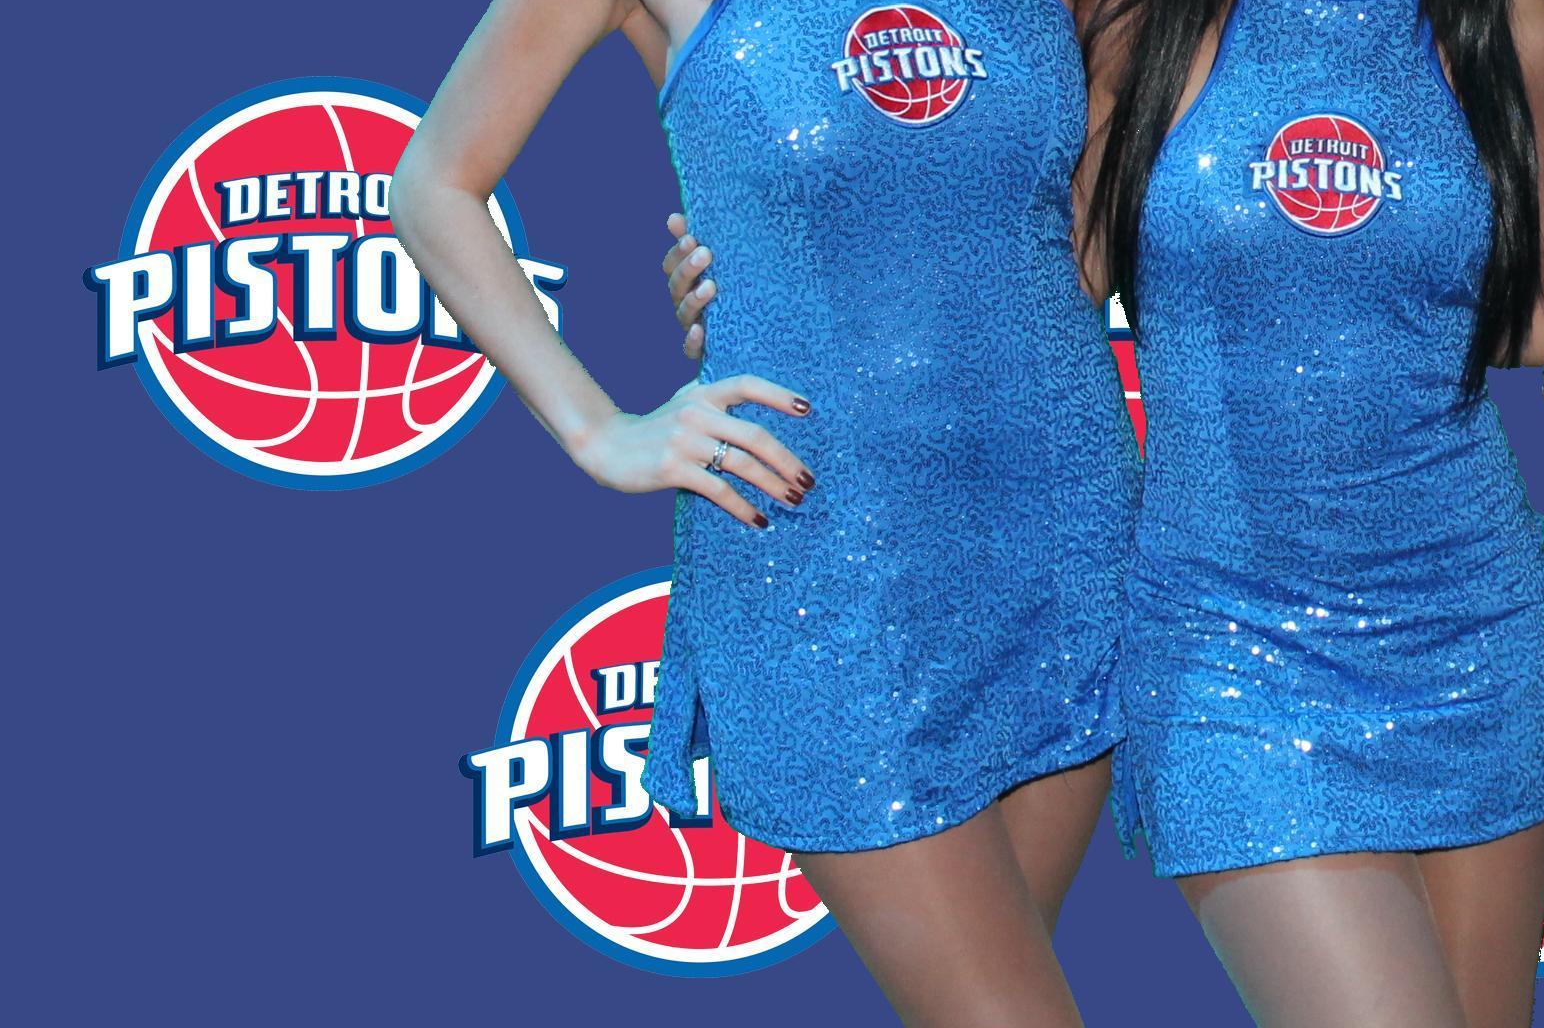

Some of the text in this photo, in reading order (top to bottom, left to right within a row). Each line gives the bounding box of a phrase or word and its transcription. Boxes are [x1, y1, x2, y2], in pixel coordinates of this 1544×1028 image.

[863, 27, 944, 49] DETROIT
[831, 46, 989, 92] PISTONS
[217, 171, 392, 228] DETRO
[1249, 157, 1402, 201] PISTONS
